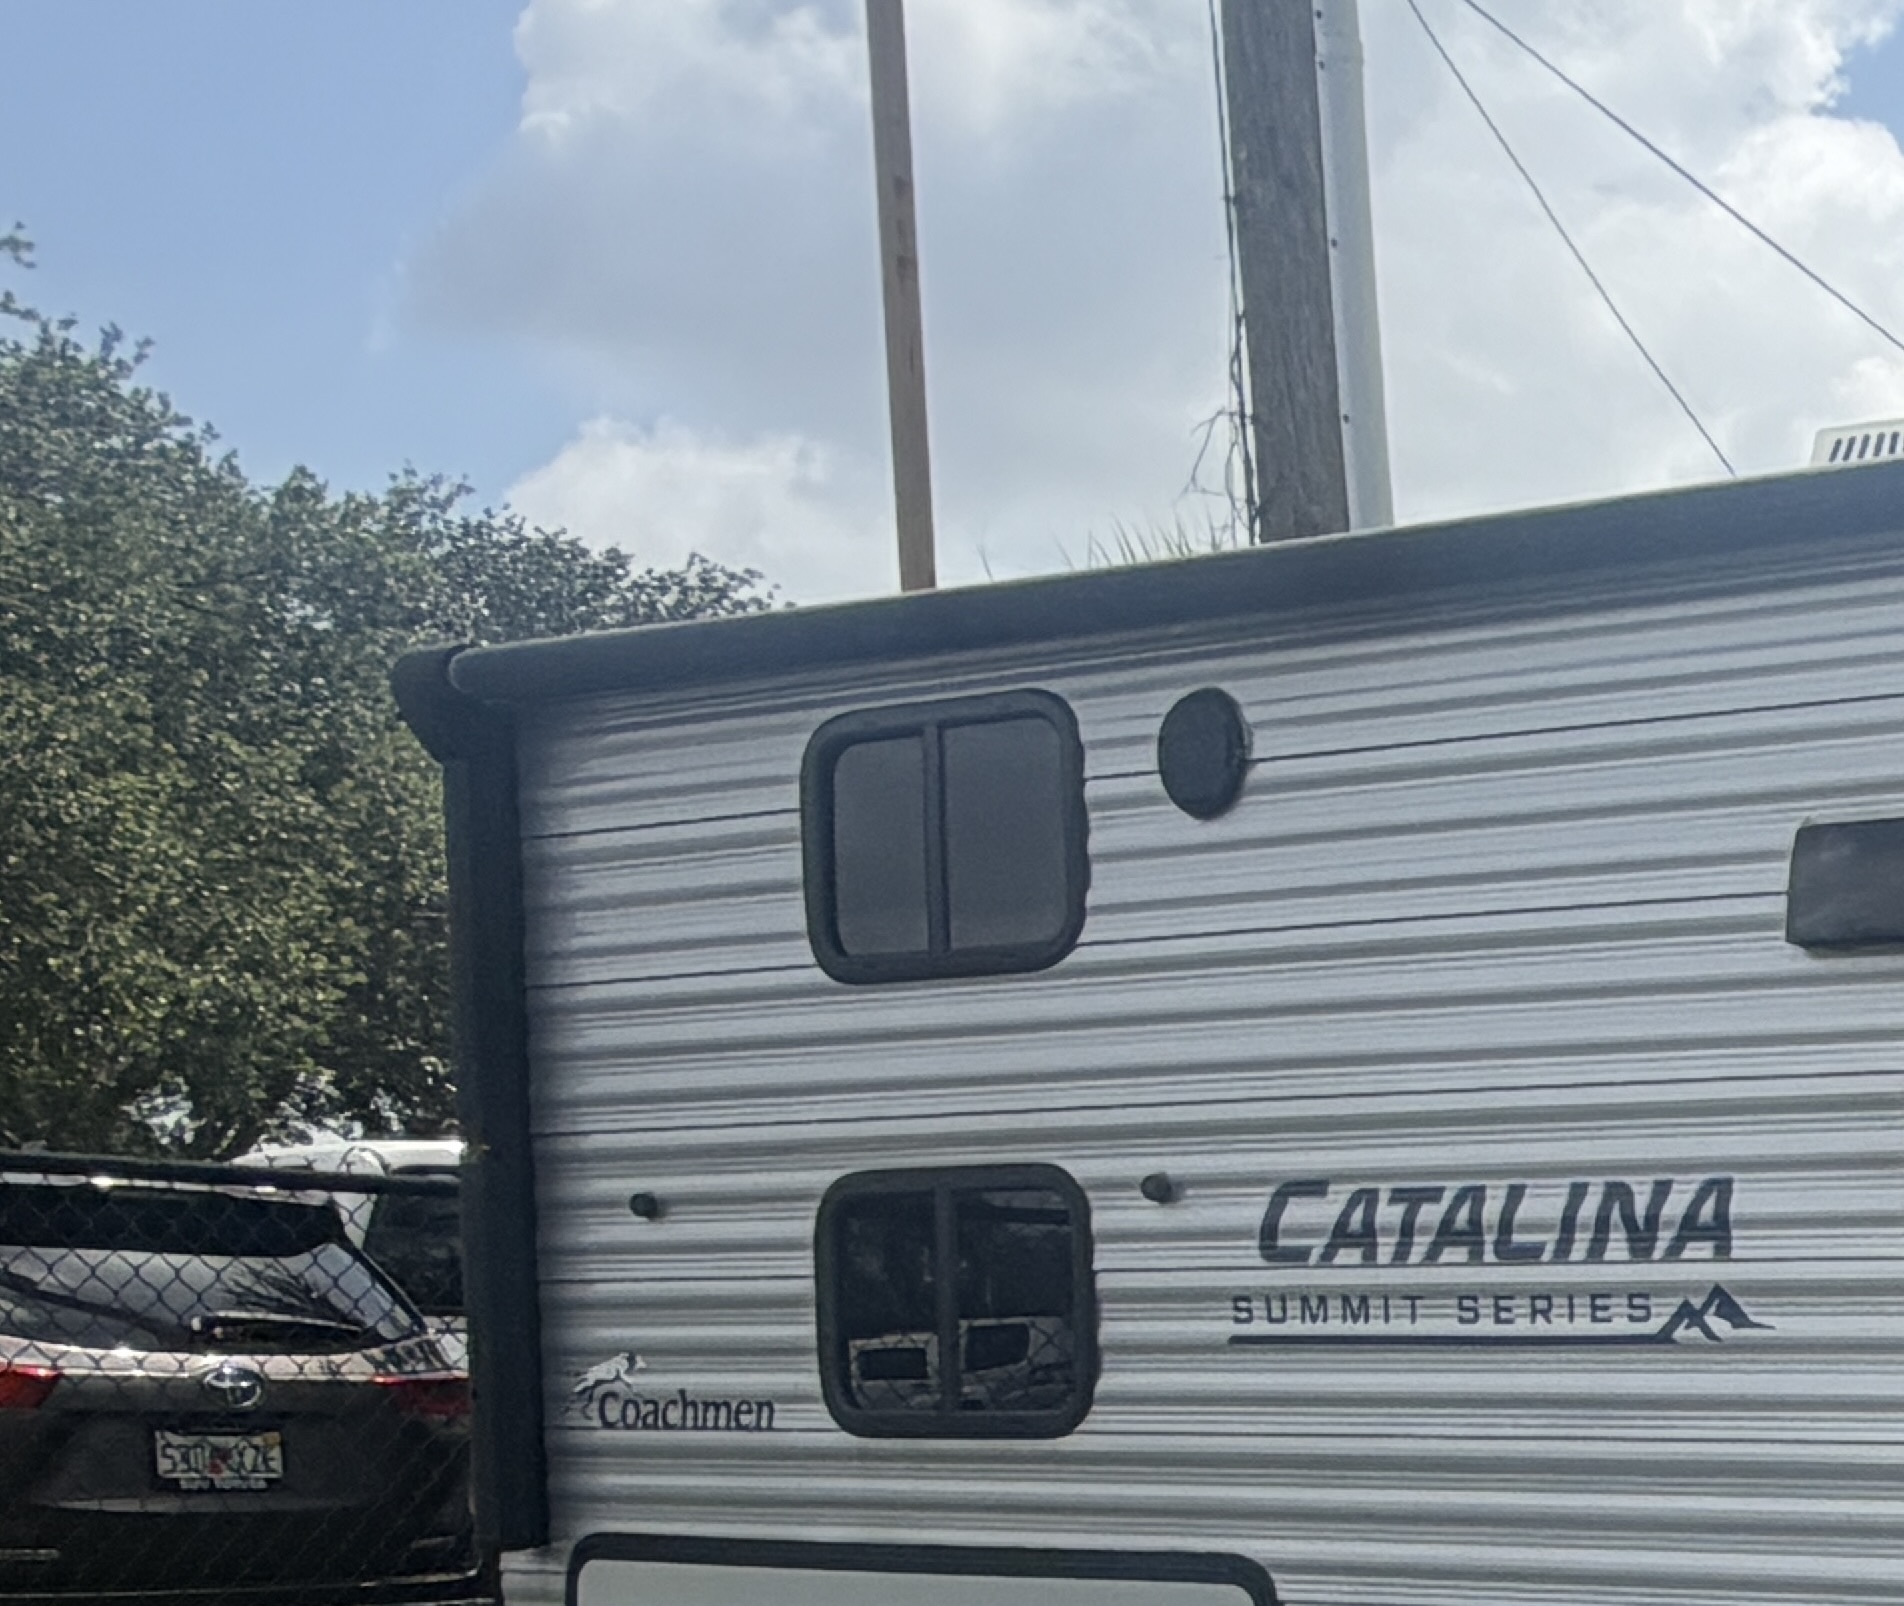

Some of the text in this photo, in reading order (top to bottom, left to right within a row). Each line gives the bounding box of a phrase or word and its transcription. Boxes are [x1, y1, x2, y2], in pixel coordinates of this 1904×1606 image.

[1258, 1176, 1734, 1265] CATALINA
[1233, 1292, 1652, 1325] SUMMIT SERIES
[599, 1388, 774, 1430] Coachmen
